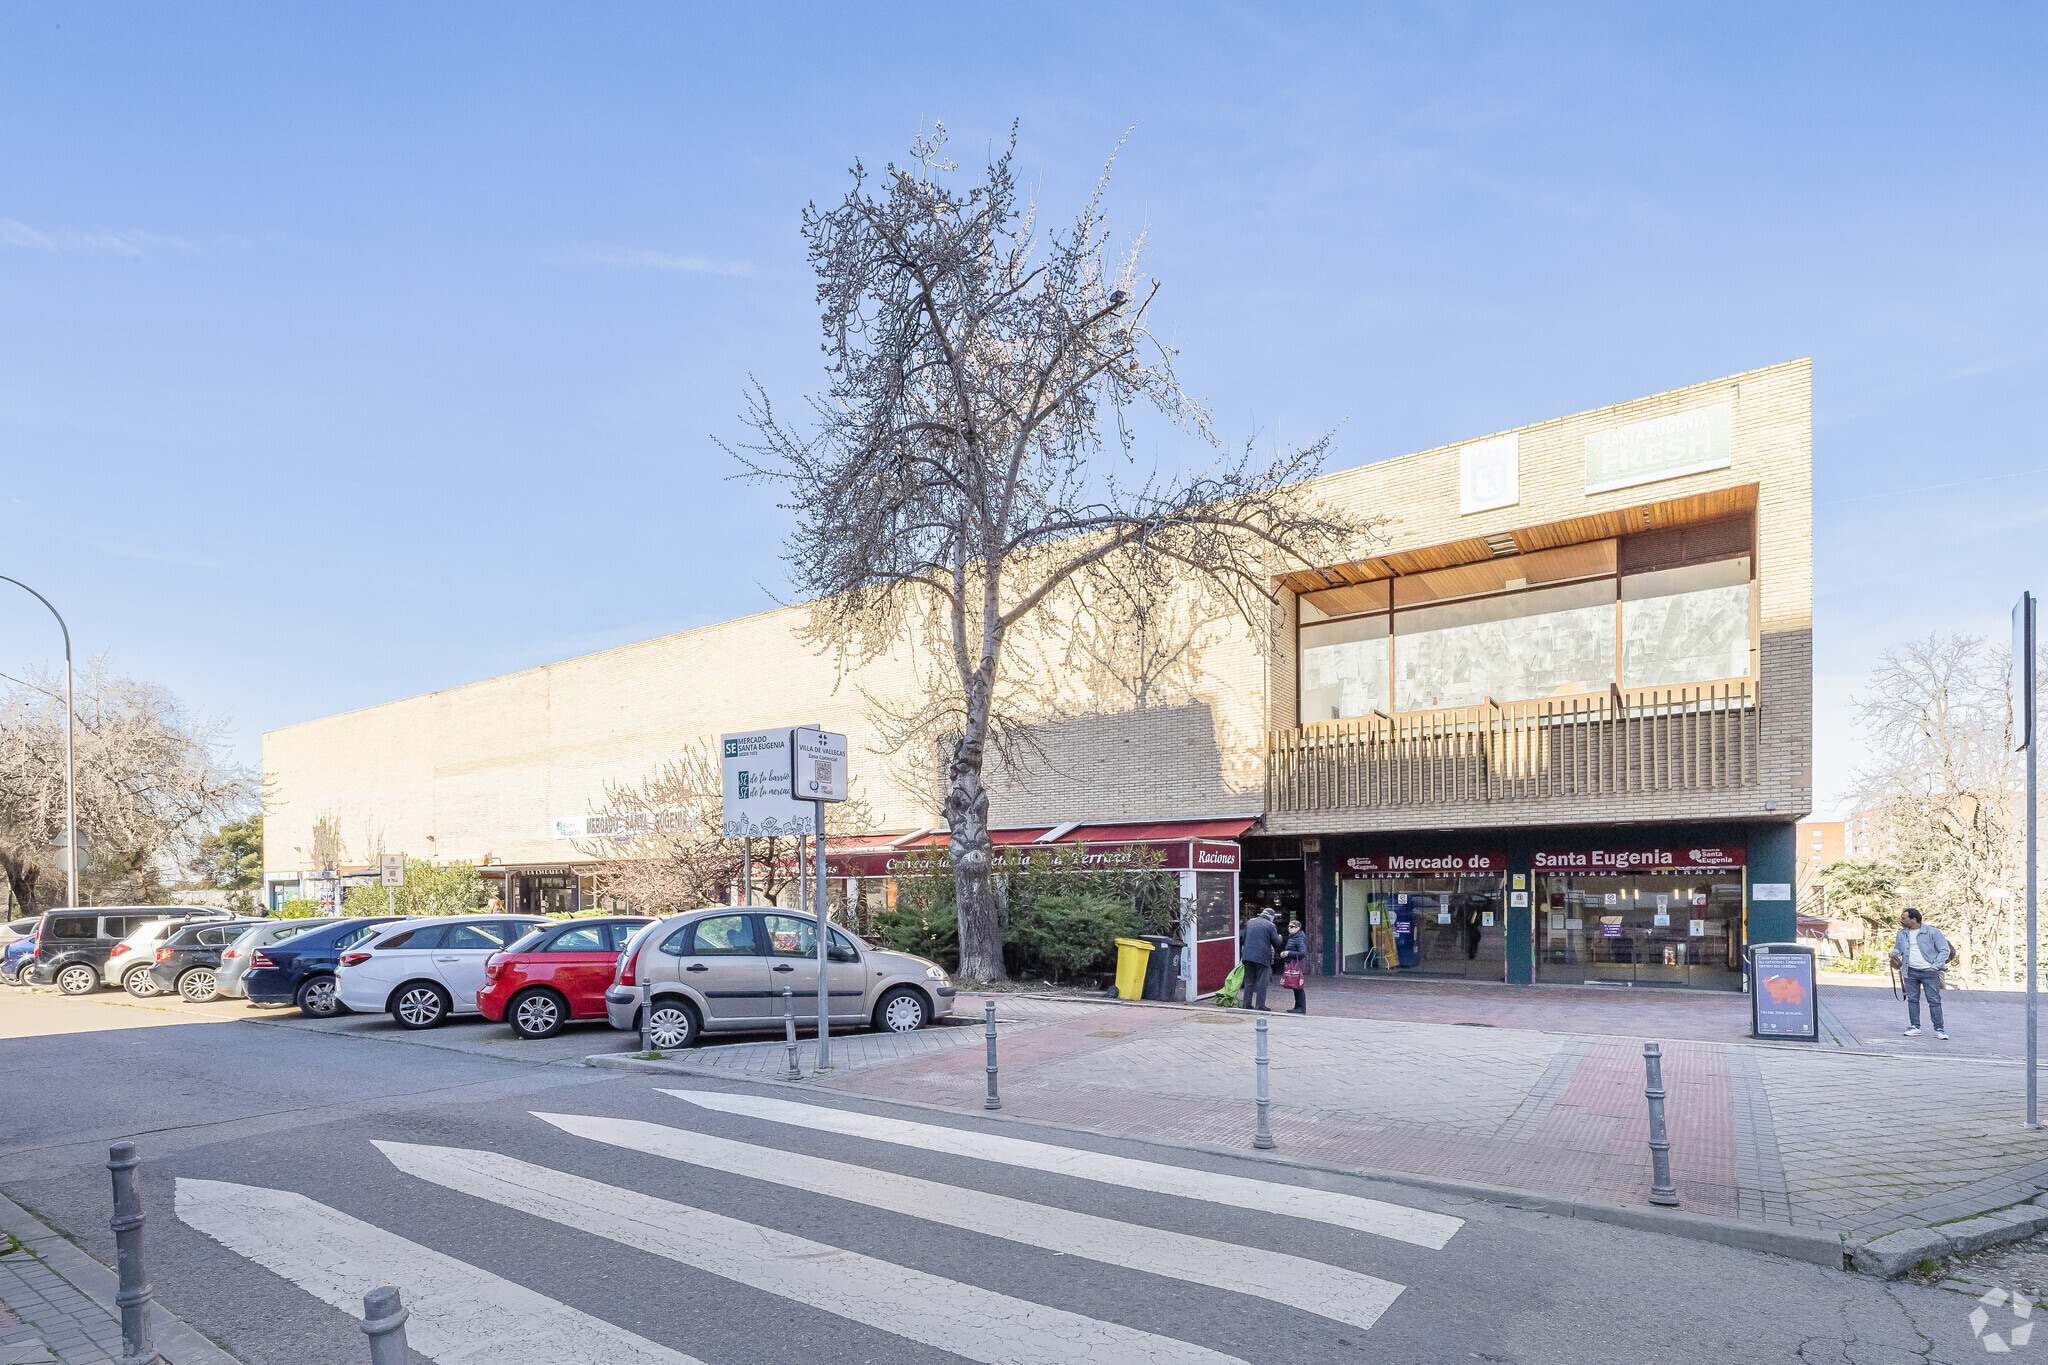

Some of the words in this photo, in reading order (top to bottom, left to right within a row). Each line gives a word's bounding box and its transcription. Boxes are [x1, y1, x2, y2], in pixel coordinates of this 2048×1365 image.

[1601, 430, 1712, 474] FRESH
[738, 735, 767, 745] MERCADO
[738, 744, 758, 752] SANTA
[758, 741, 785, 751] EUGENIA
[726, 743, 737, 754] SE
[799, 744, 813, 752] VILLA
[822, 747, 846, 757] VALLECAS
[750, 772, 758, 784] de
[768, 768, 790, 782] barrio
[750, 786, 758, 798] de
[768, 787, 790, 797] merca
[1197, 850, 1236, 865] Raciones
[1388, 854, 1464, 870] Mercado
[1468, 854, 1491, 869] de
[1535, 852, 1587, 867] Santa
[1591, 848, 1673, 868] Eugenia
